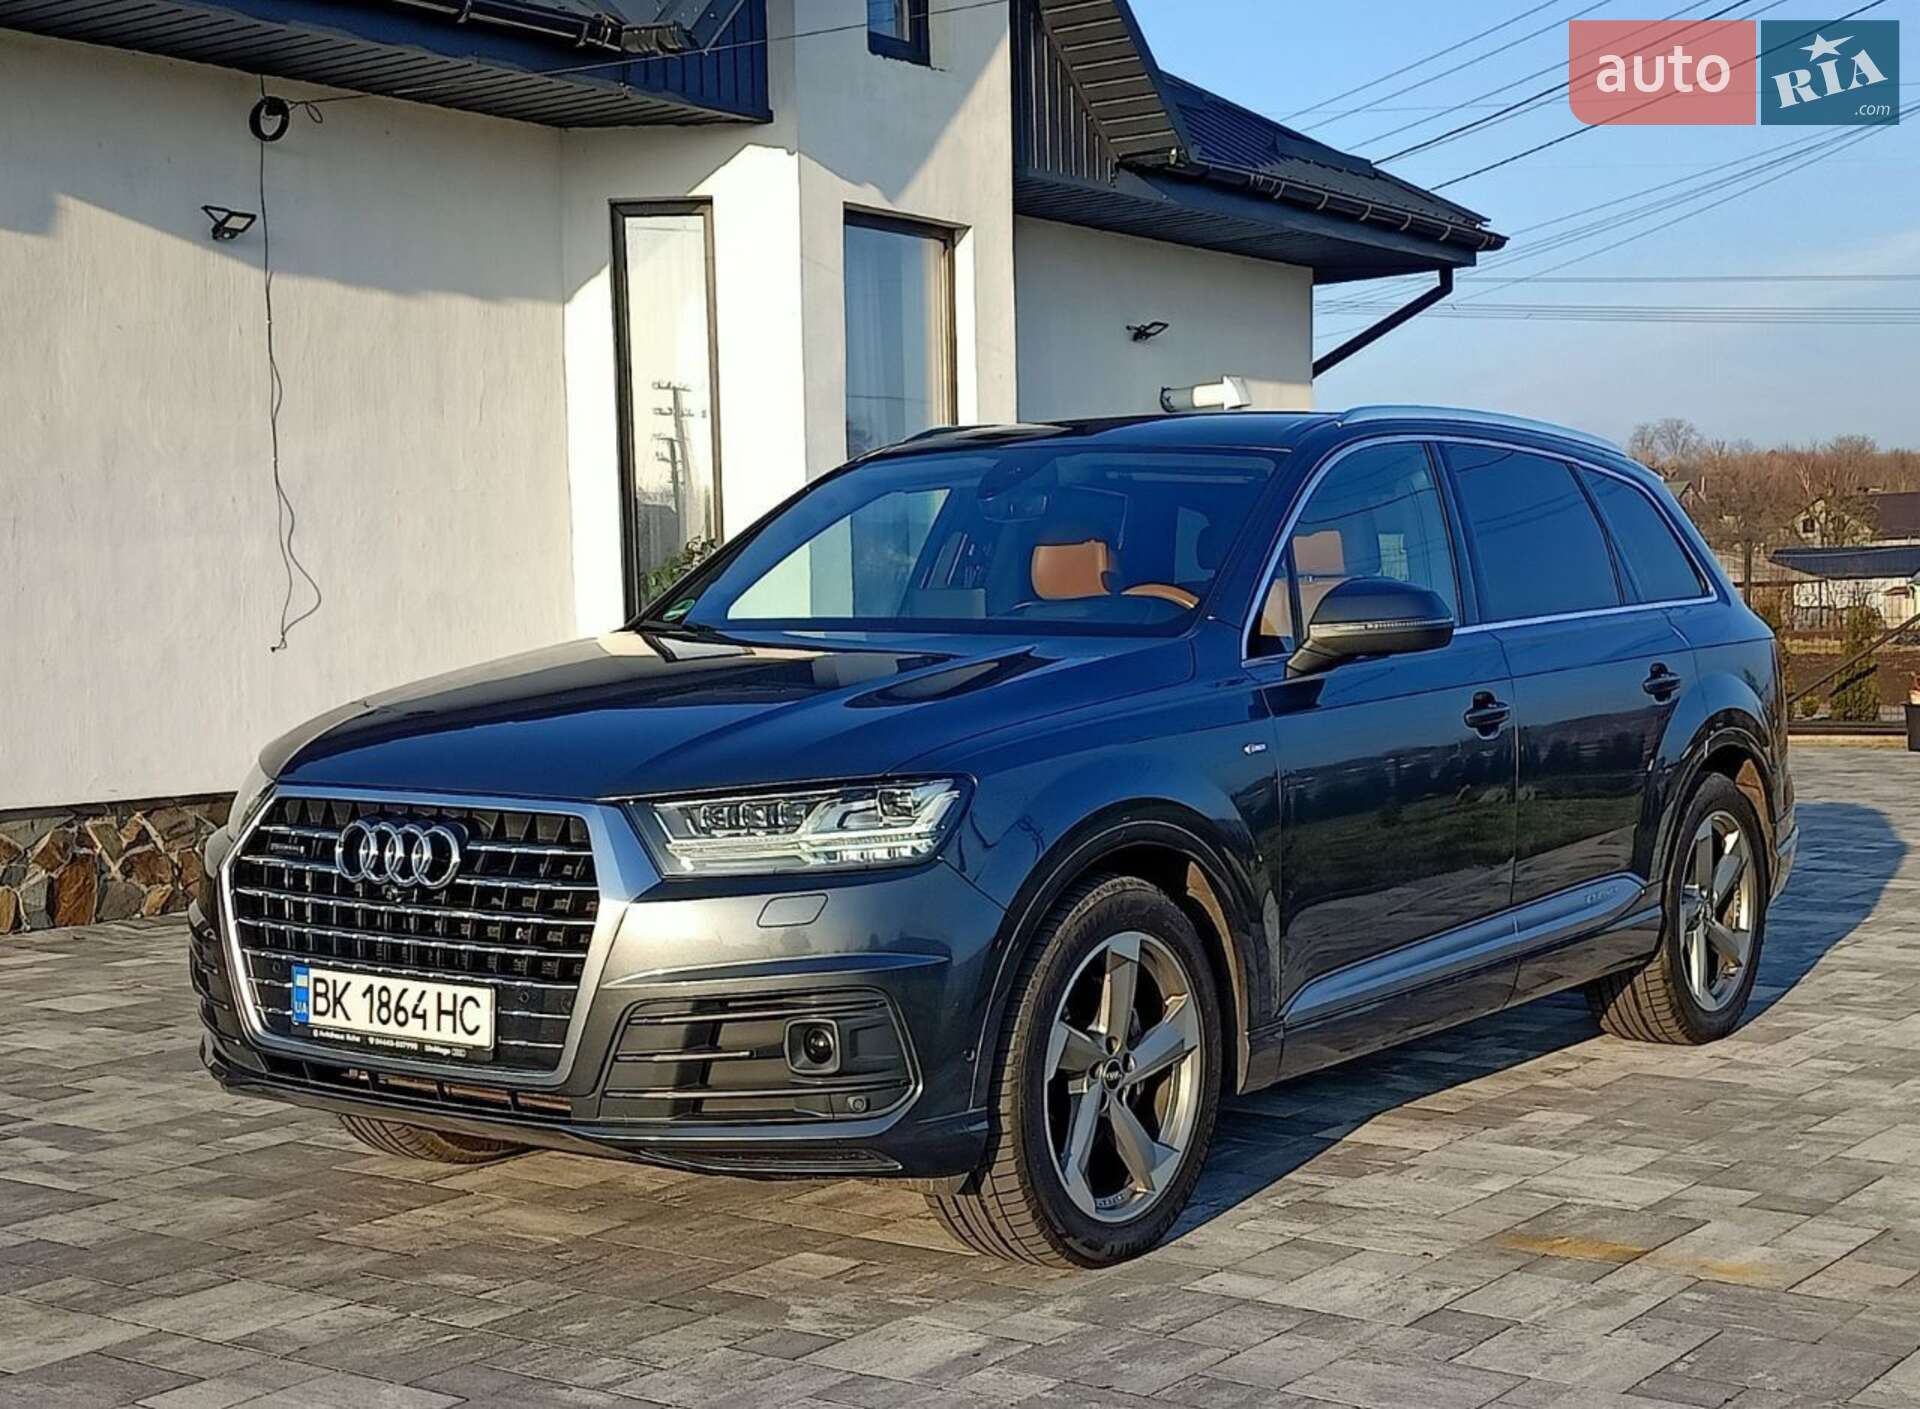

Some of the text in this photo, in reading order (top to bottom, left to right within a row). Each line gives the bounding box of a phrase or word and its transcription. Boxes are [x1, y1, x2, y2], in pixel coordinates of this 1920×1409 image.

[312, 977, 481, 1036] BK 1864 HC
